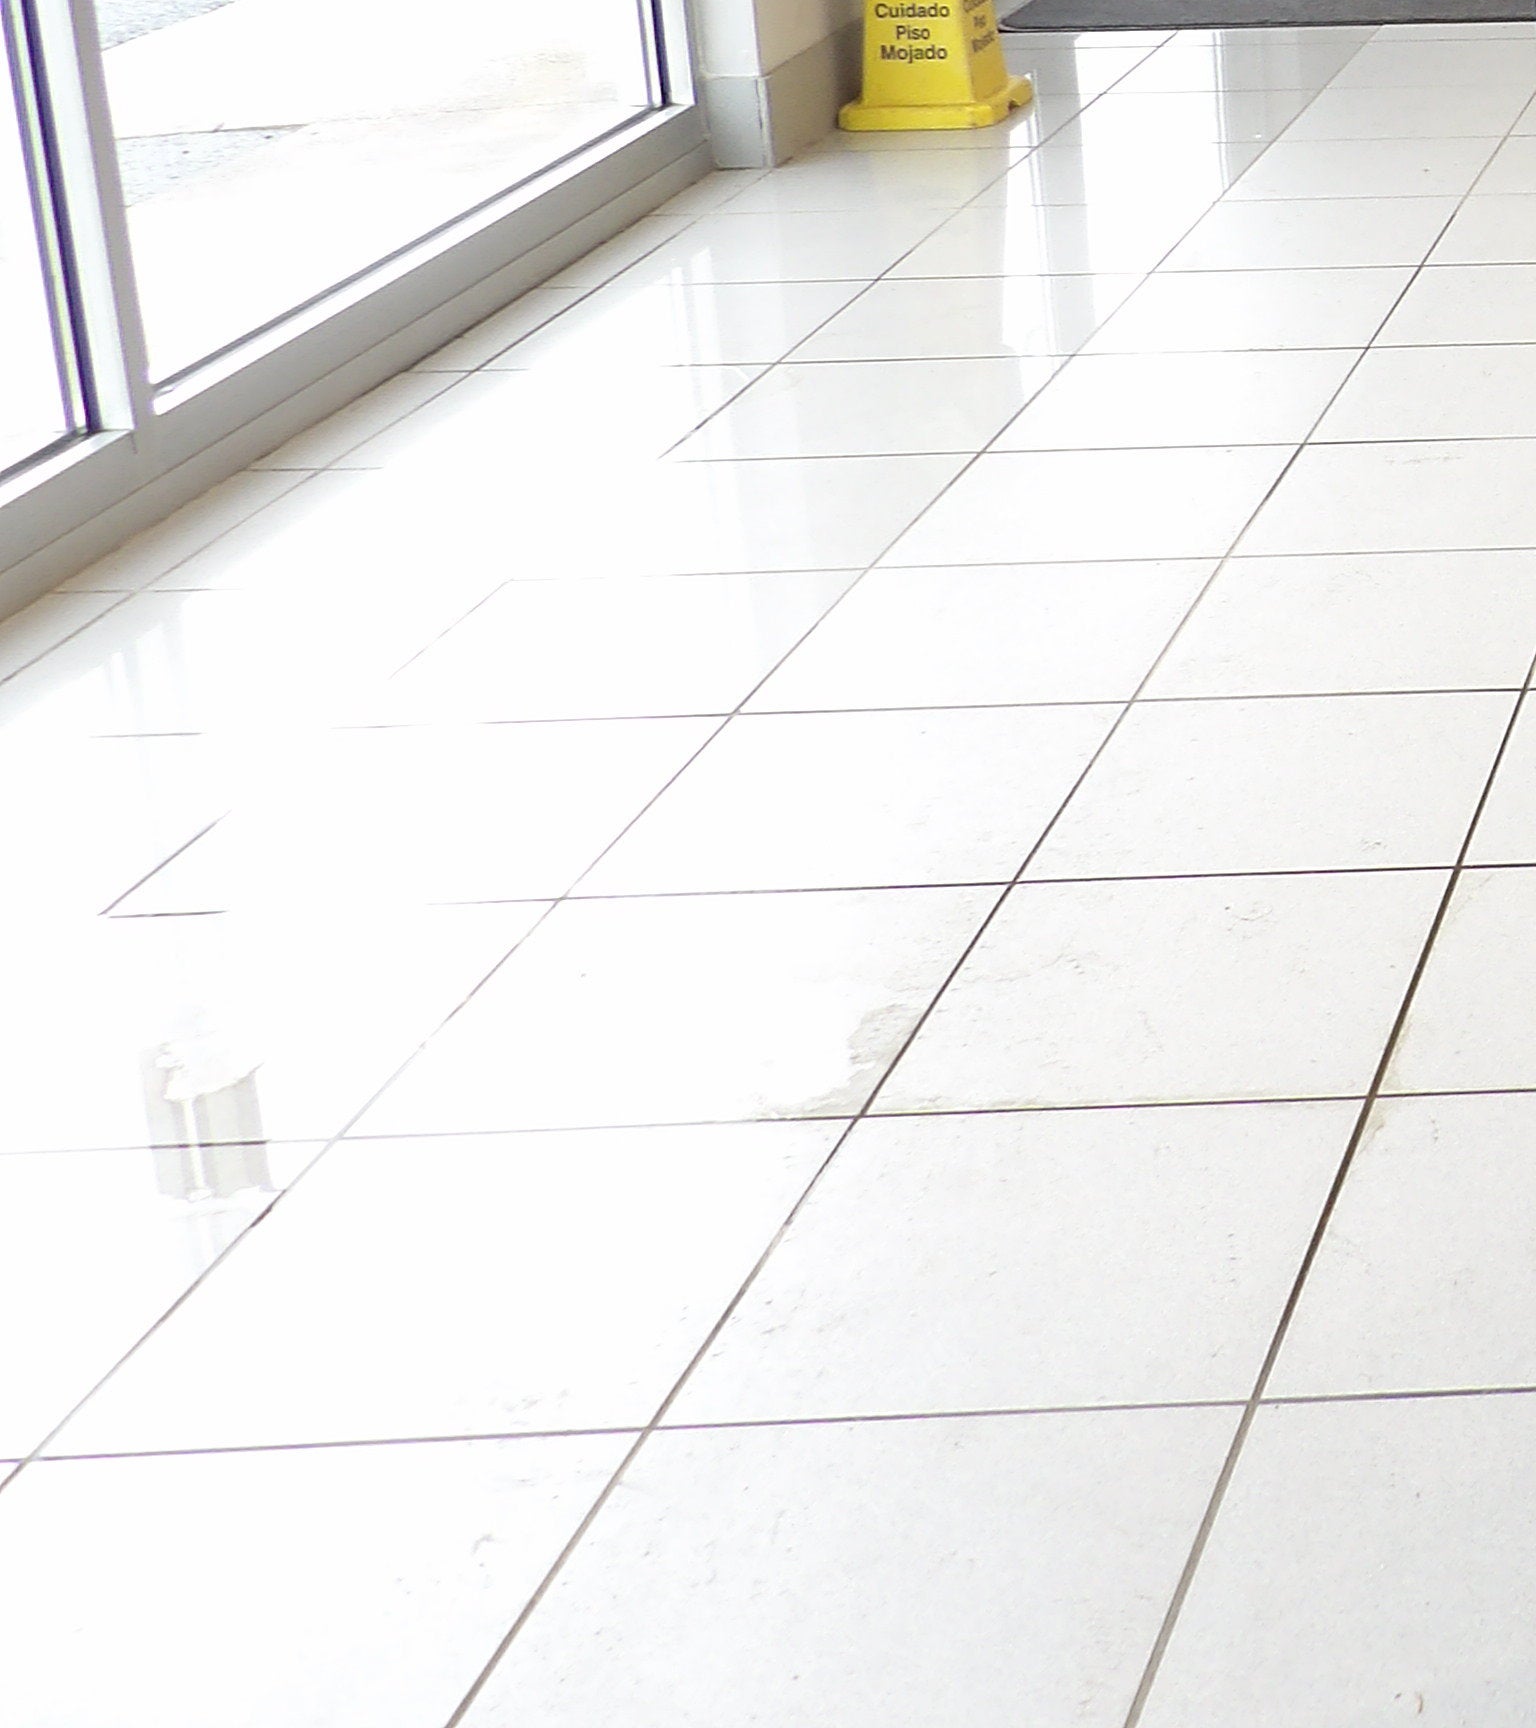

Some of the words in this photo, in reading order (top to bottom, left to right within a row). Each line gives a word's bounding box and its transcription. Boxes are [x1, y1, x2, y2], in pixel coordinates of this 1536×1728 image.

[874, 2, 950, 19] Cuidado
[895, 24, 931, 40] Piso
[880, 44, 948, 64] Mojado
